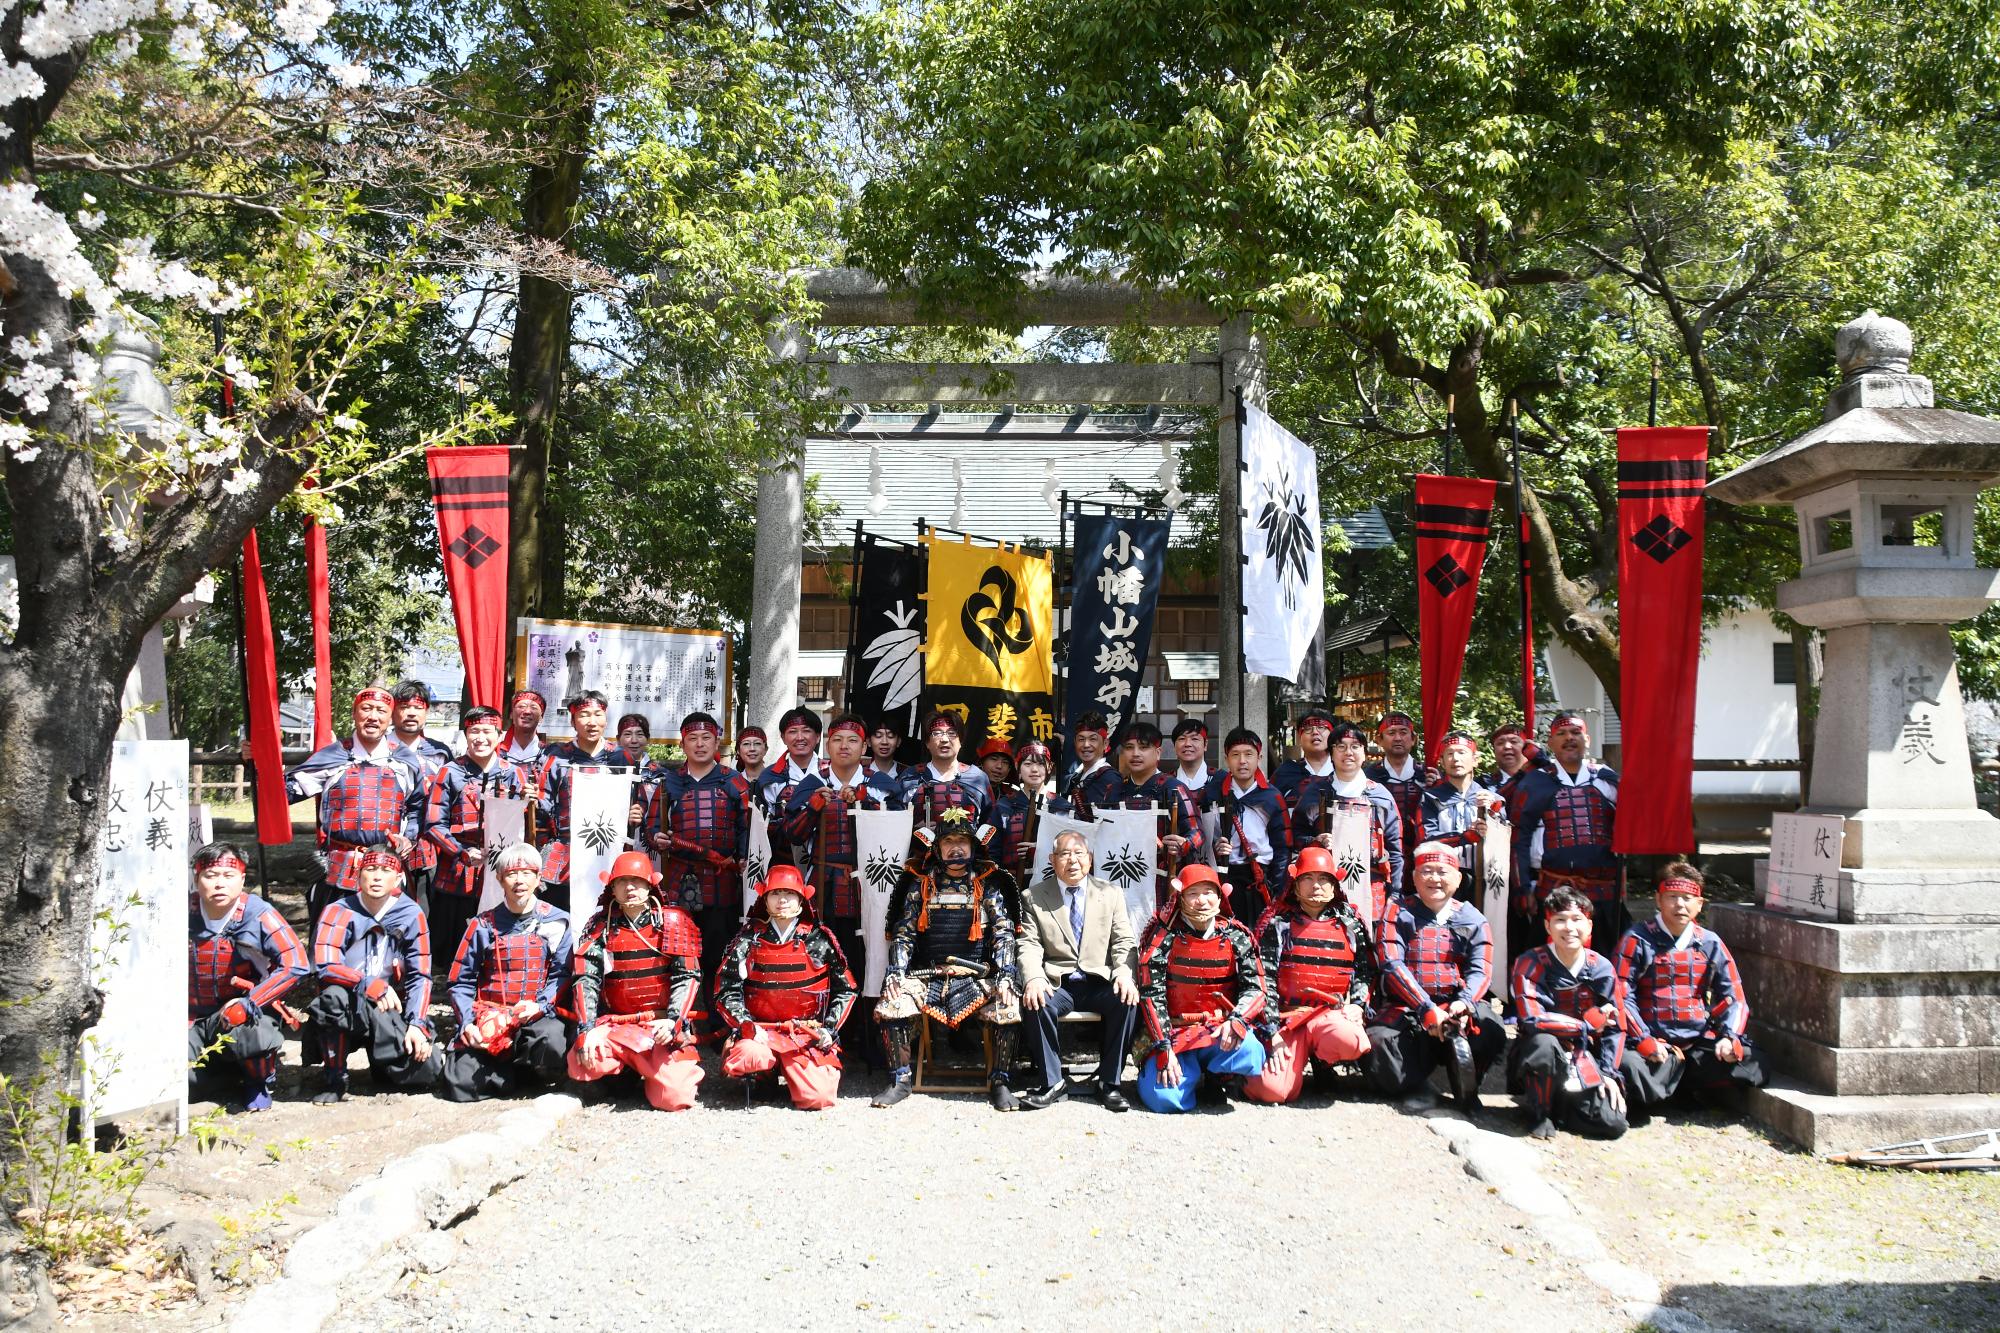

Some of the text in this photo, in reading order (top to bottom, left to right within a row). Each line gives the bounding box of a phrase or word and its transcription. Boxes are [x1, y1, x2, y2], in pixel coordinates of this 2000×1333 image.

[703, 651, 717, 712] 山縣神社
[1892, 665, 1946, 765] 仗義
[143, 780, 175, 852] 仗義
[1810, 827, 1831, 910] 仗義
